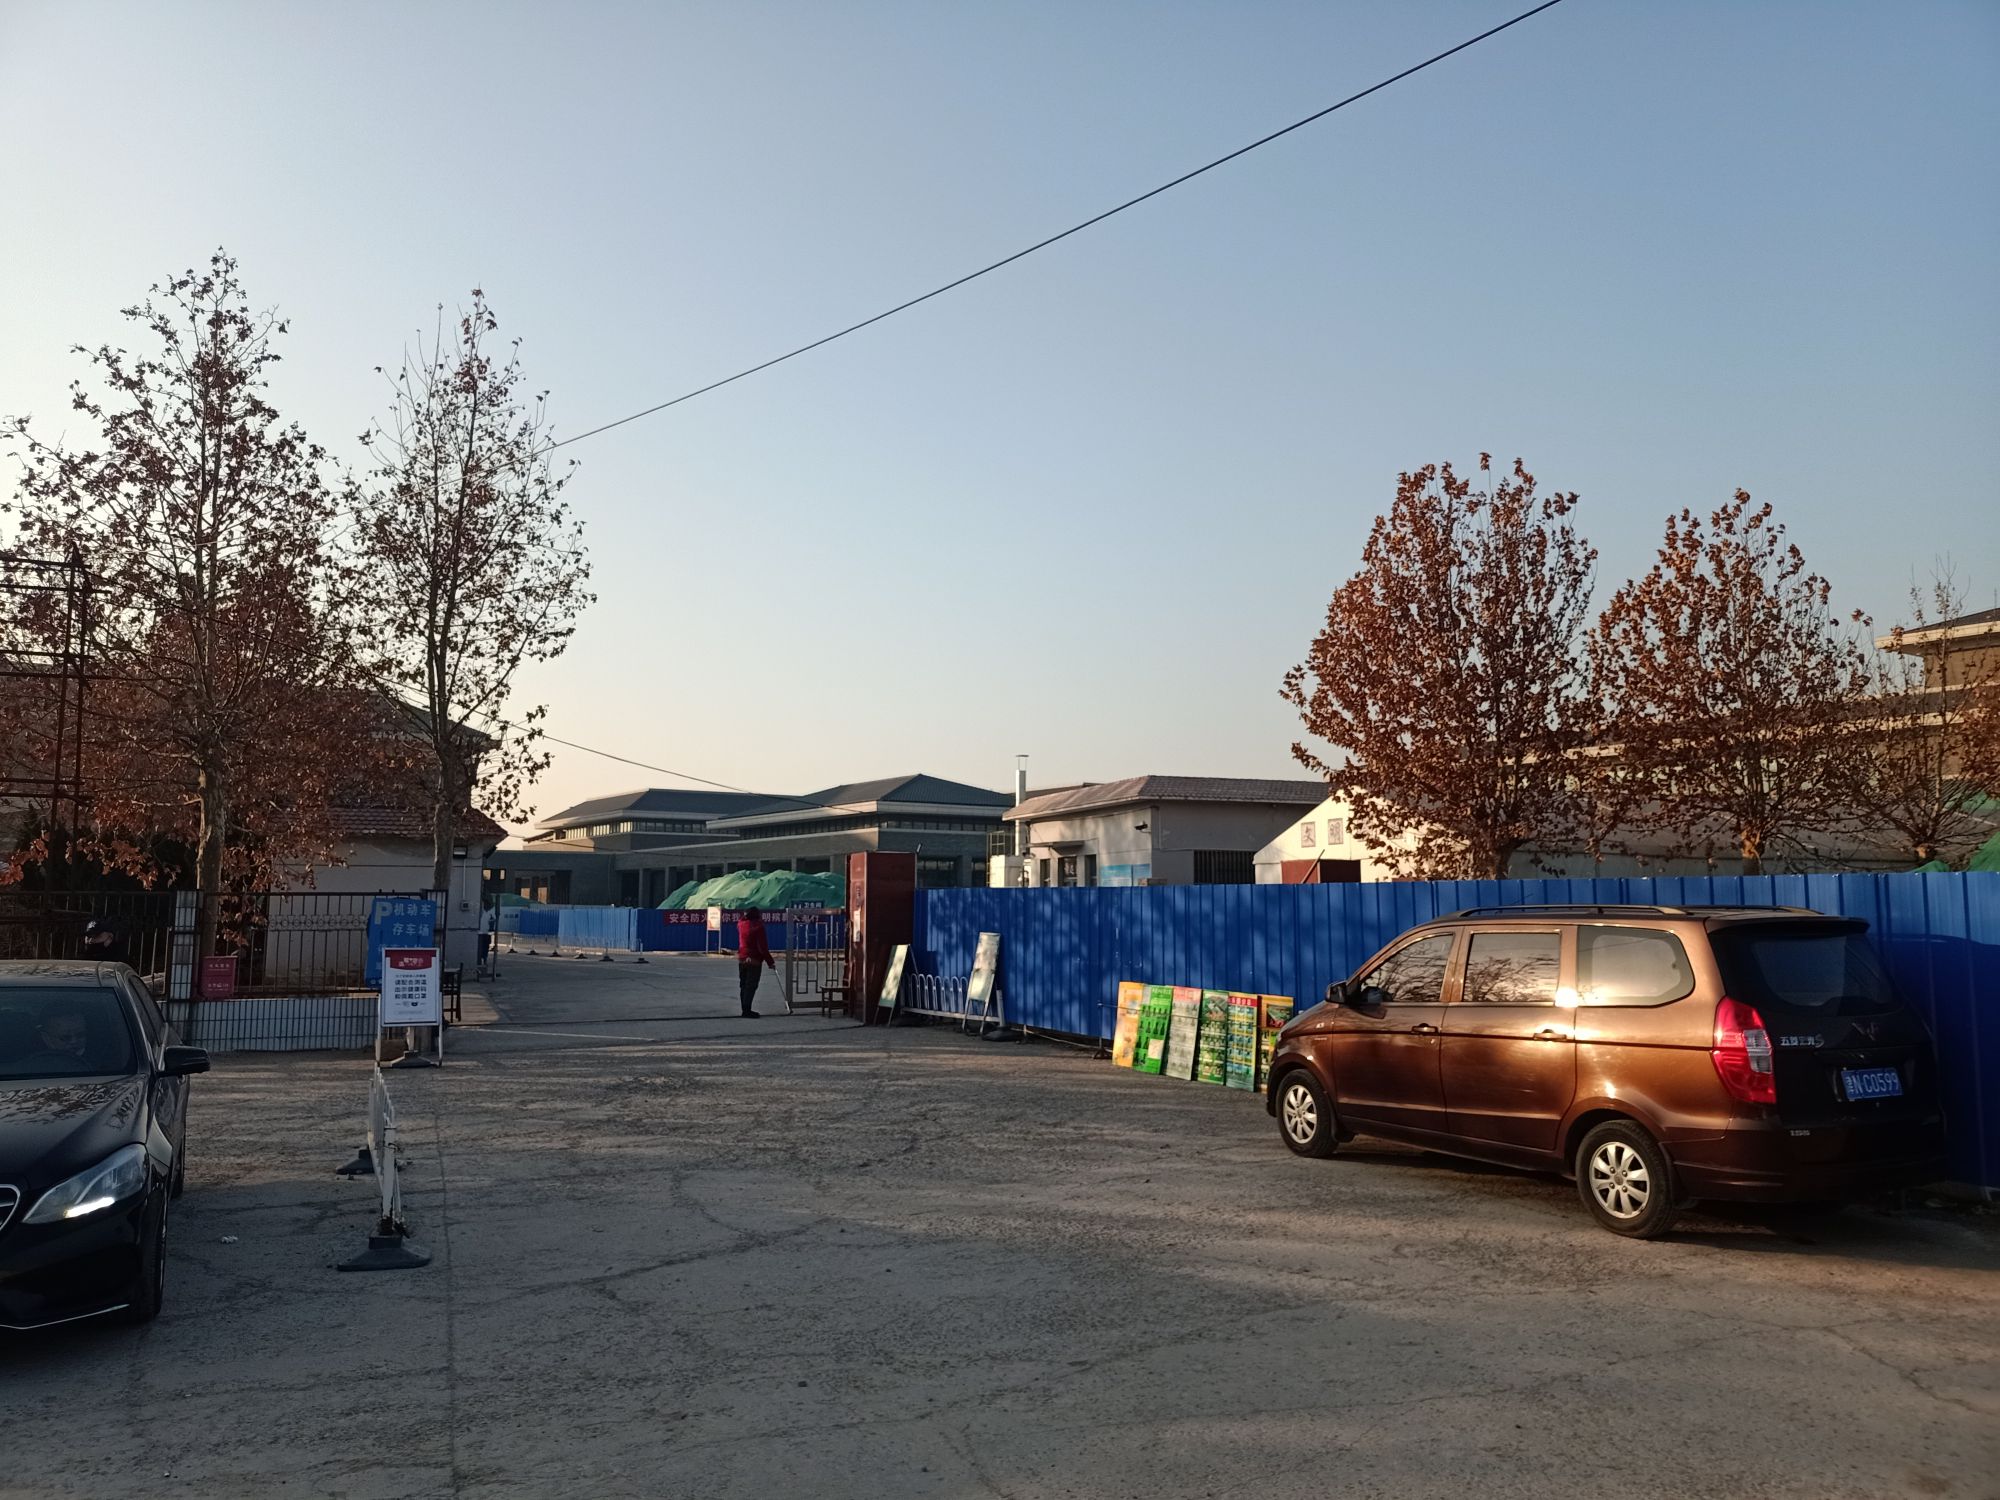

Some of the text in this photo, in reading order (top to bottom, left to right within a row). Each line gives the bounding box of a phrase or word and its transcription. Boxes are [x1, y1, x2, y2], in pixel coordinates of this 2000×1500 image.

[374, 901, 431, 925] P 机动车
[392, 922, 429, 937] 存车场
